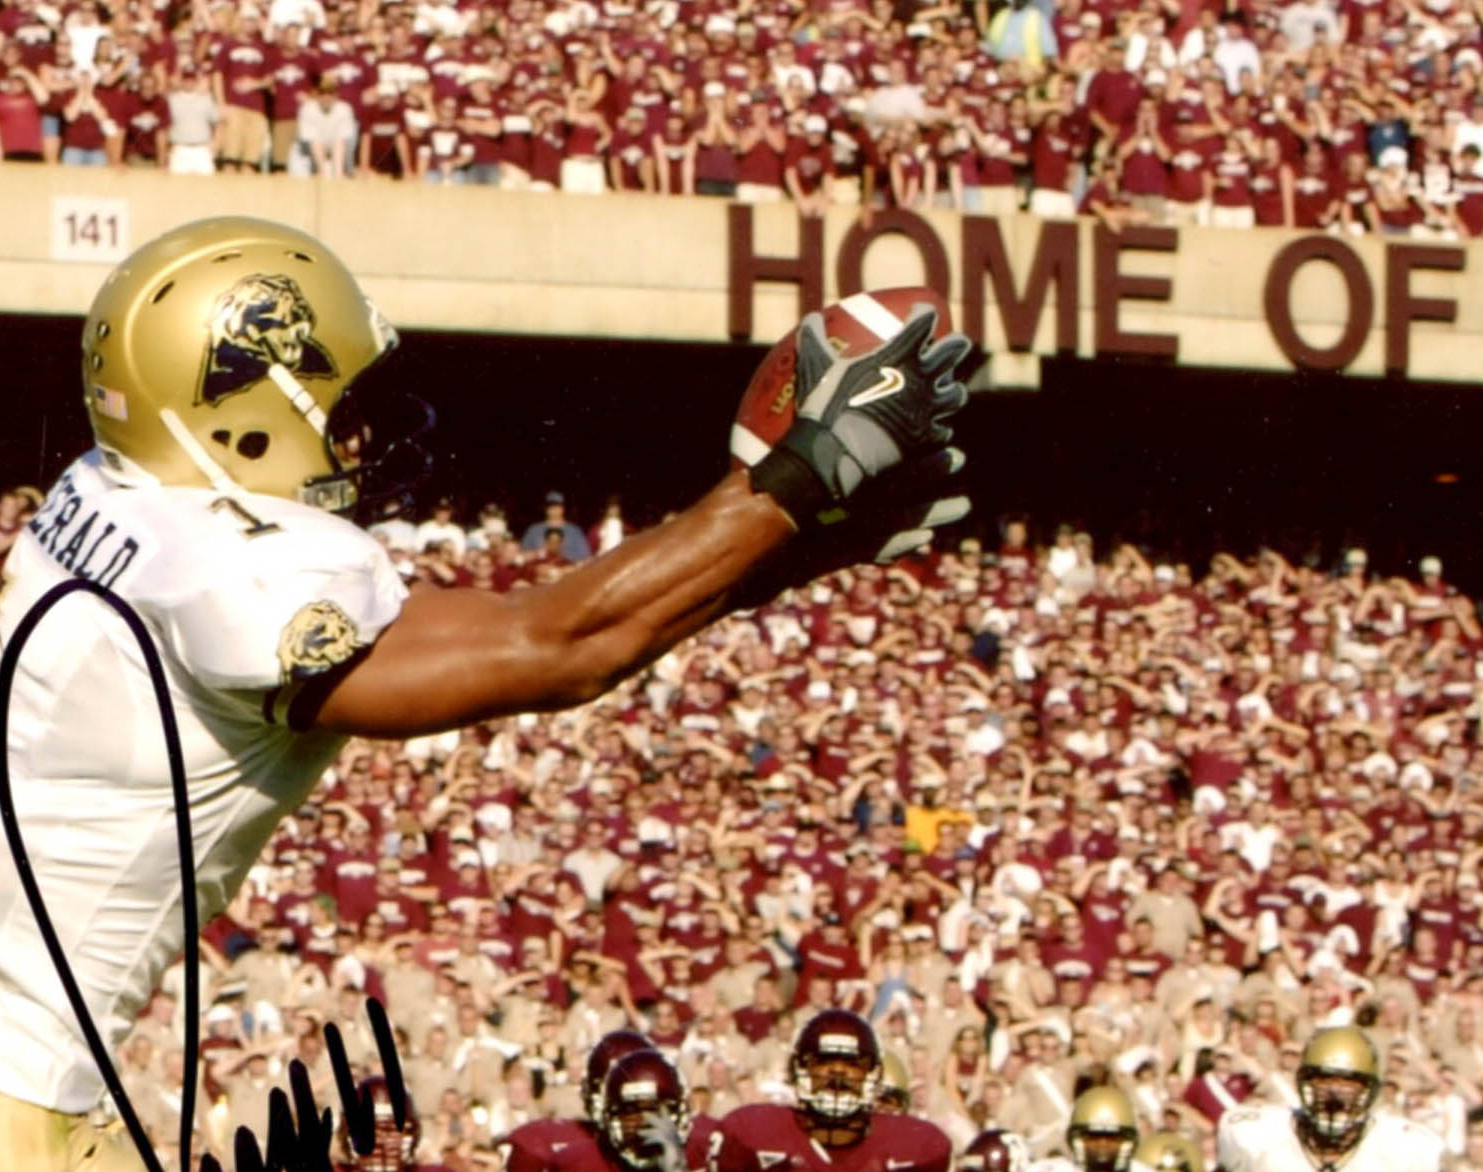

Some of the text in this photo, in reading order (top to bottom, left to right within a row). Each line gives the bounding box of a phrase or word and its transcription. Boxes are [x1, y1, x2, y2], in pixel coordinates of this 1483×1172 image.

[64, 213, 118, 246] 141
[726, 203, 1467, 377] HOME OF
